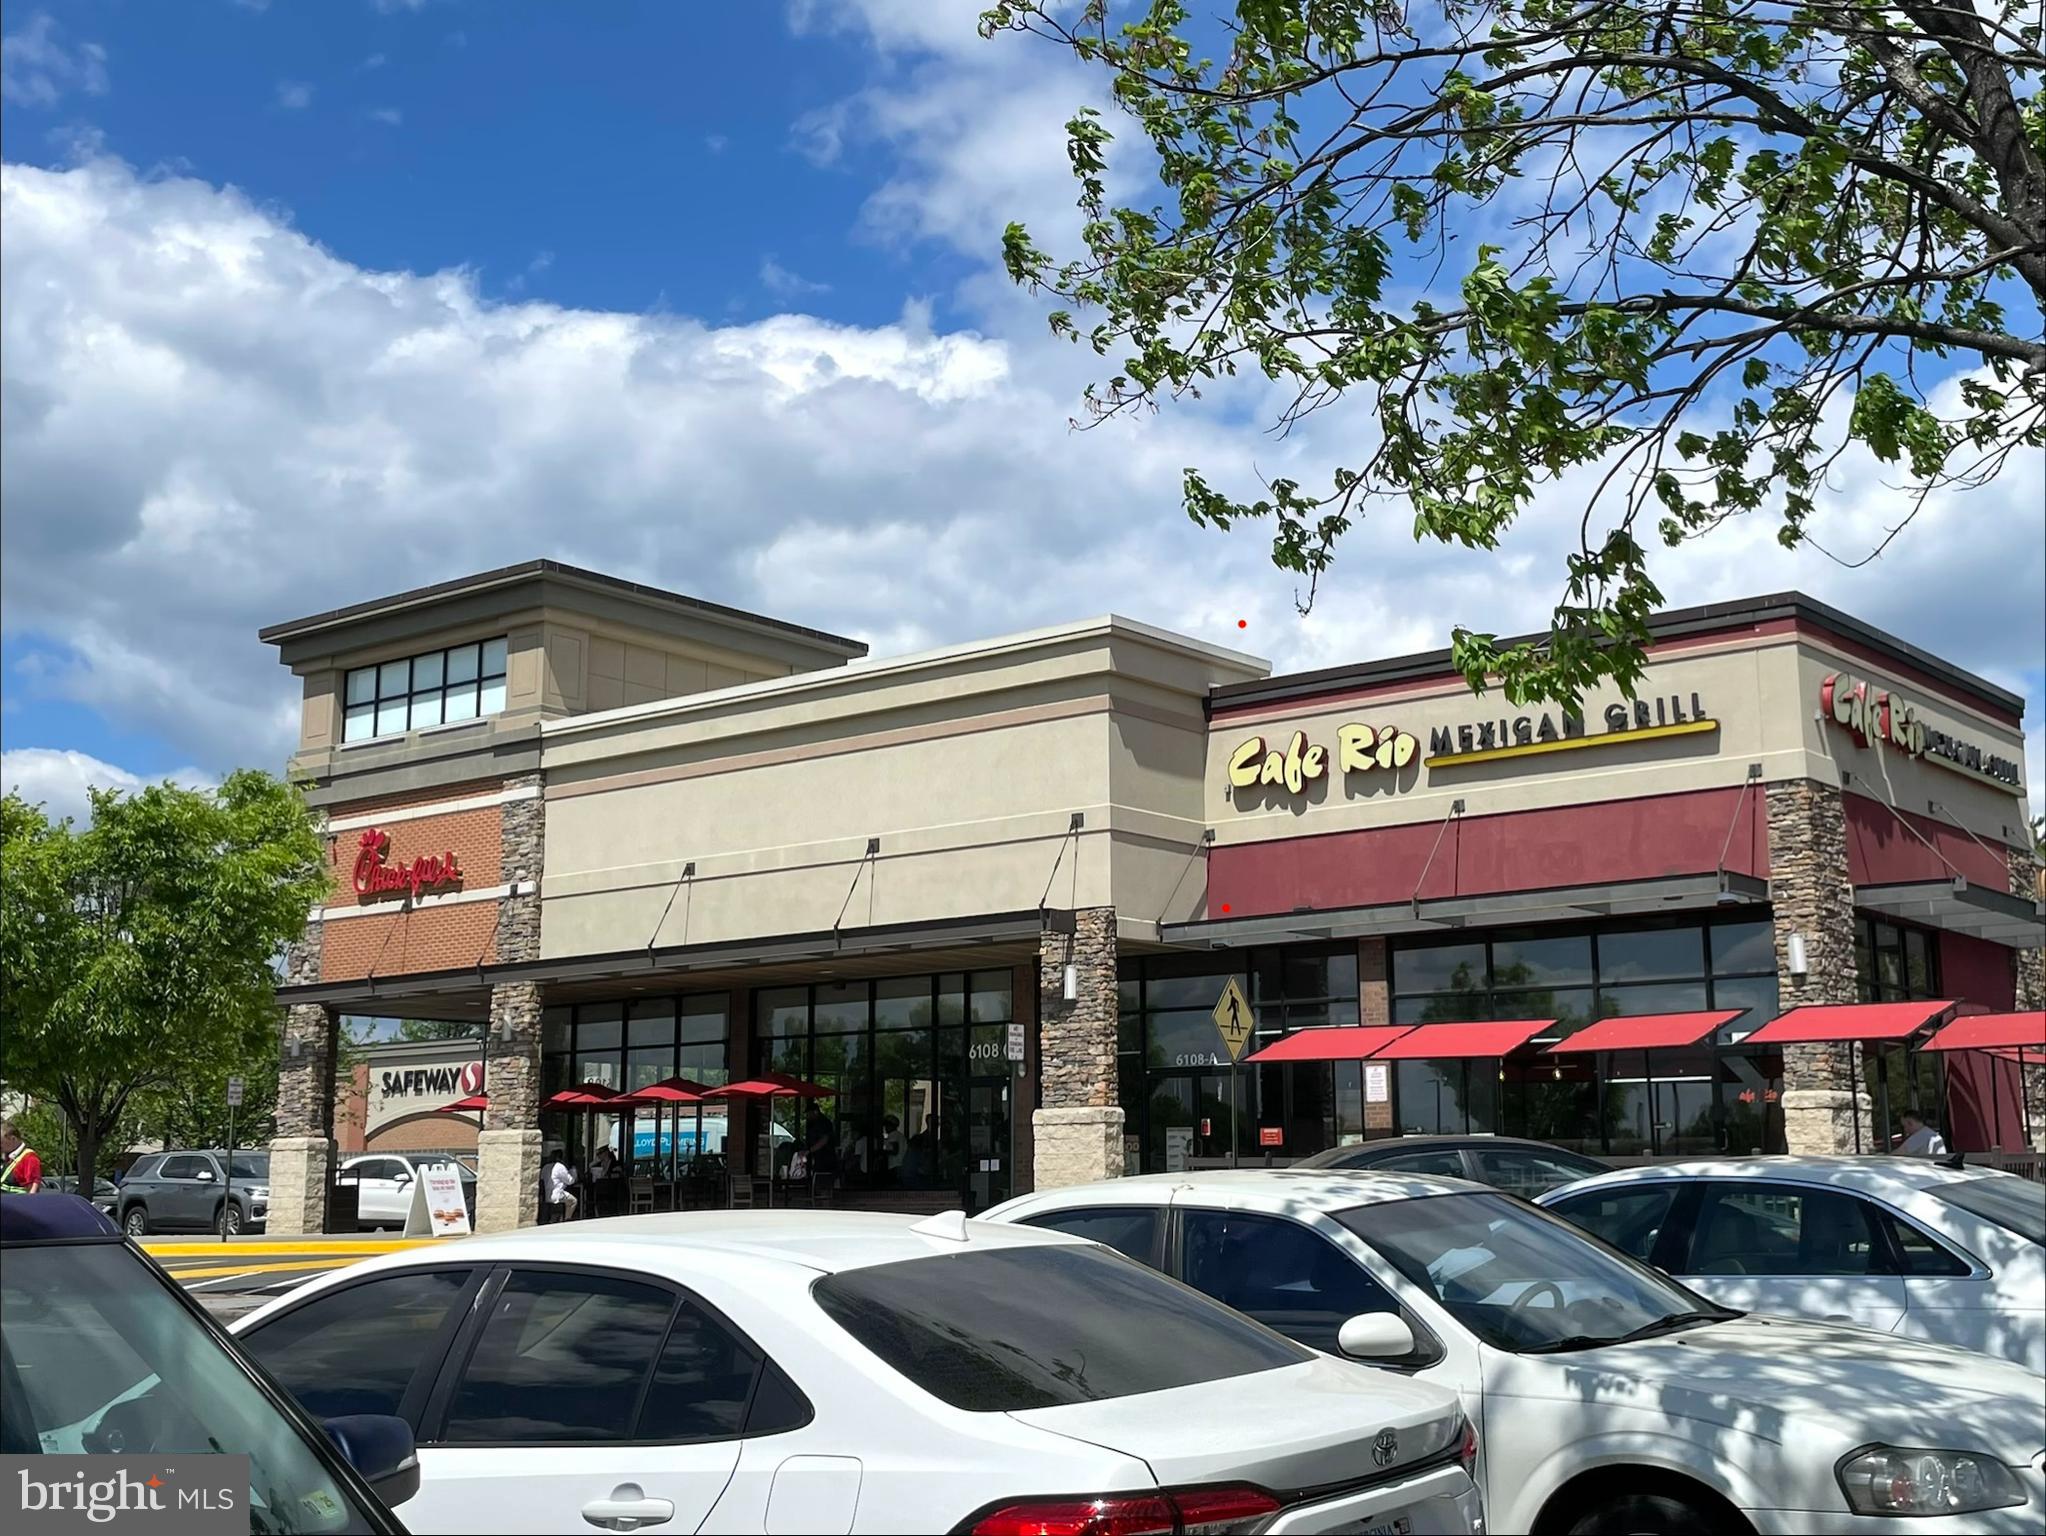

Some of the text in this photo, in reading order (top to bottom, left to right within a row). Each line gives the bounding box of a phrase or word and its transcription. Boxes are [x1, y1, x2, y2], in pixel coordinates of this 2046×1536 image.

[1824, 672, 1884, 748] Cafe
[1888, 691, 1925, 754] Rio
[1228, 693, 1706, 794] Cafe Rio MEXICAN GRILL
[969, 1043, 999, 1059] 6108
[1176, 1052, 1218, 1066] 6108-A
[381, 1067, 461, 1098] SAFEWAY
